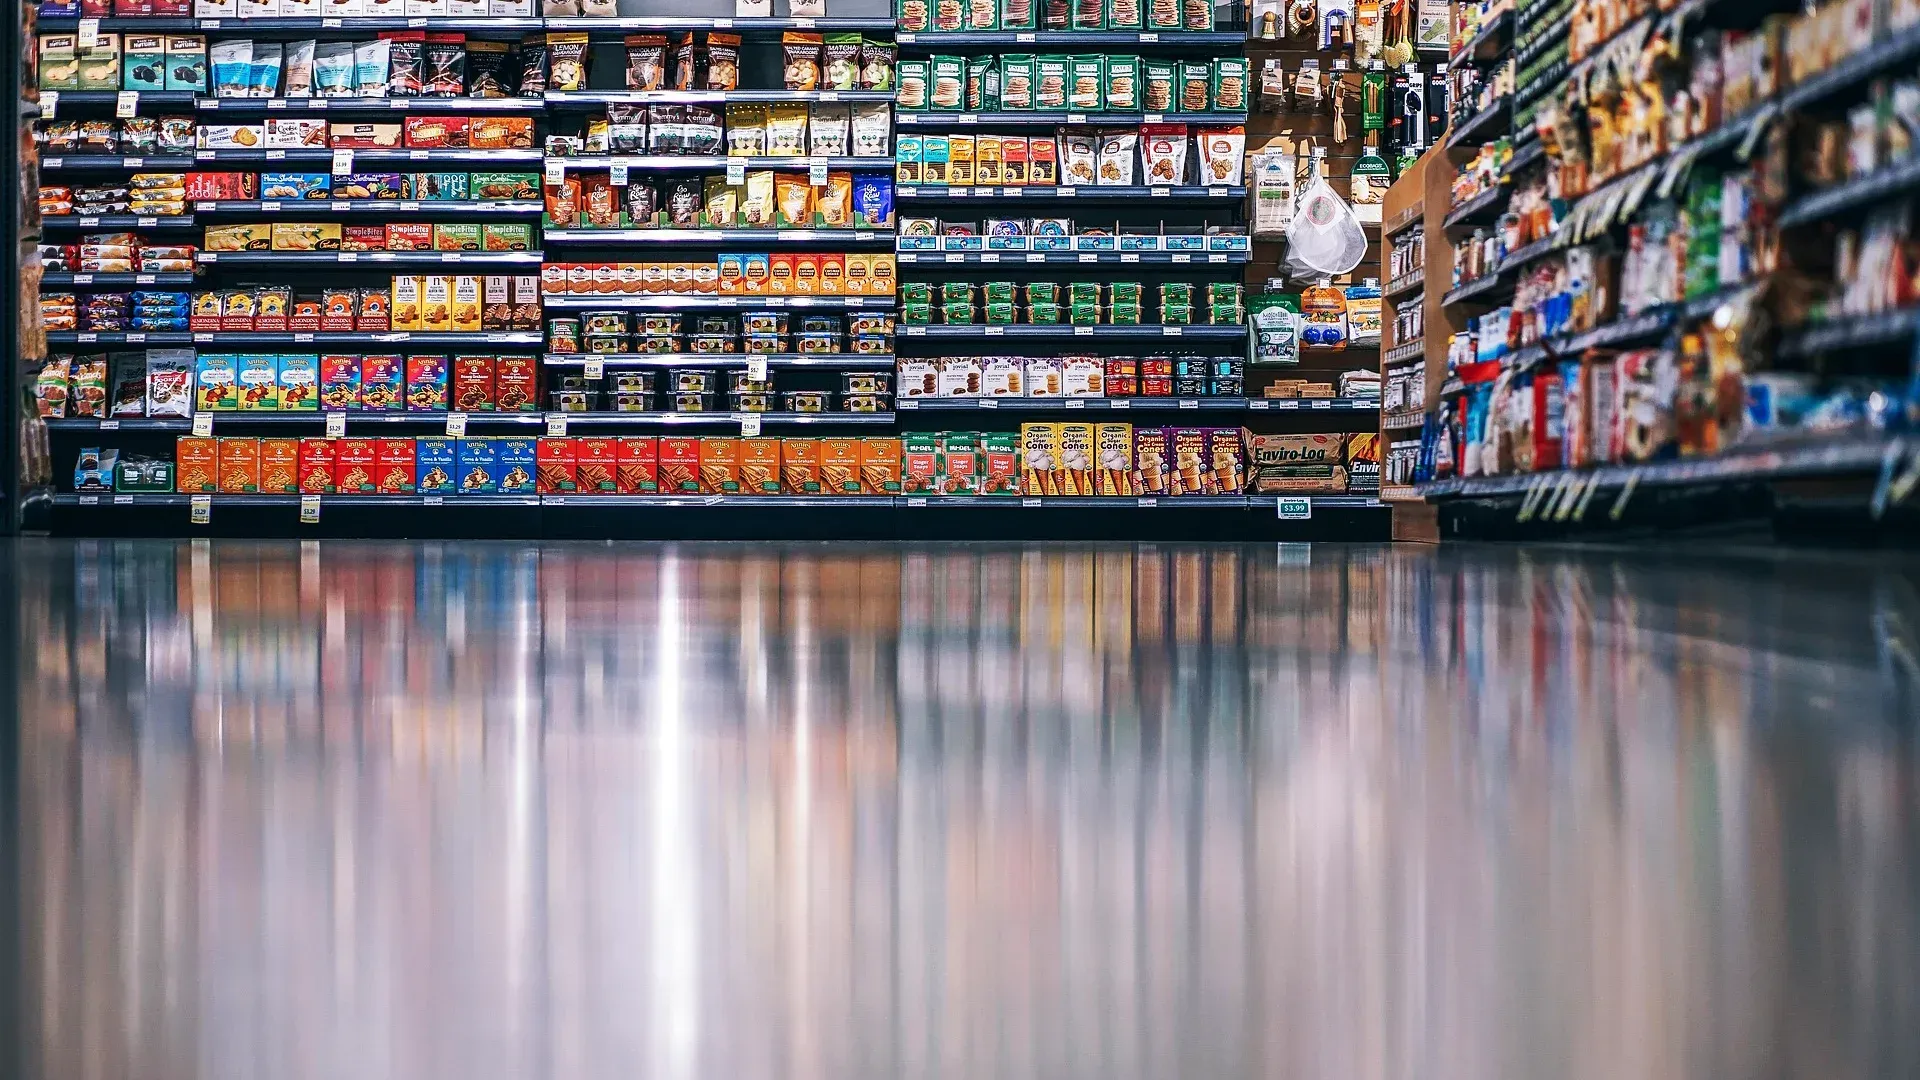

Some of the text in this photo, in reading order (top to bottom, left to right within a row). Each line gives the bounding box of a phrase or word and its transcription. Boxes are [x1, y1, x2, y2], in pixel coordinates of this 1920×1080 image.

[657, 113, 680, 121] emmy's
[692, 114, 716, 122] emmy's
[594, 183, 604, 192] Go
[633, 183, 643, 192] Go
[677, 184, 688, 193] Go
[867, 184, 877, 193] Go
[557, 189, 573, 199] Raw
[591, 190, 607, 201] Raw
[630, 189, 647, 200] Raw
[672, 191, 691, 202] Raw
[863, 191, 880, 201] Raw
[392, 225, 429, 233] SimpleBites
[1256, 447, 1326, 462] Enviro-Log
